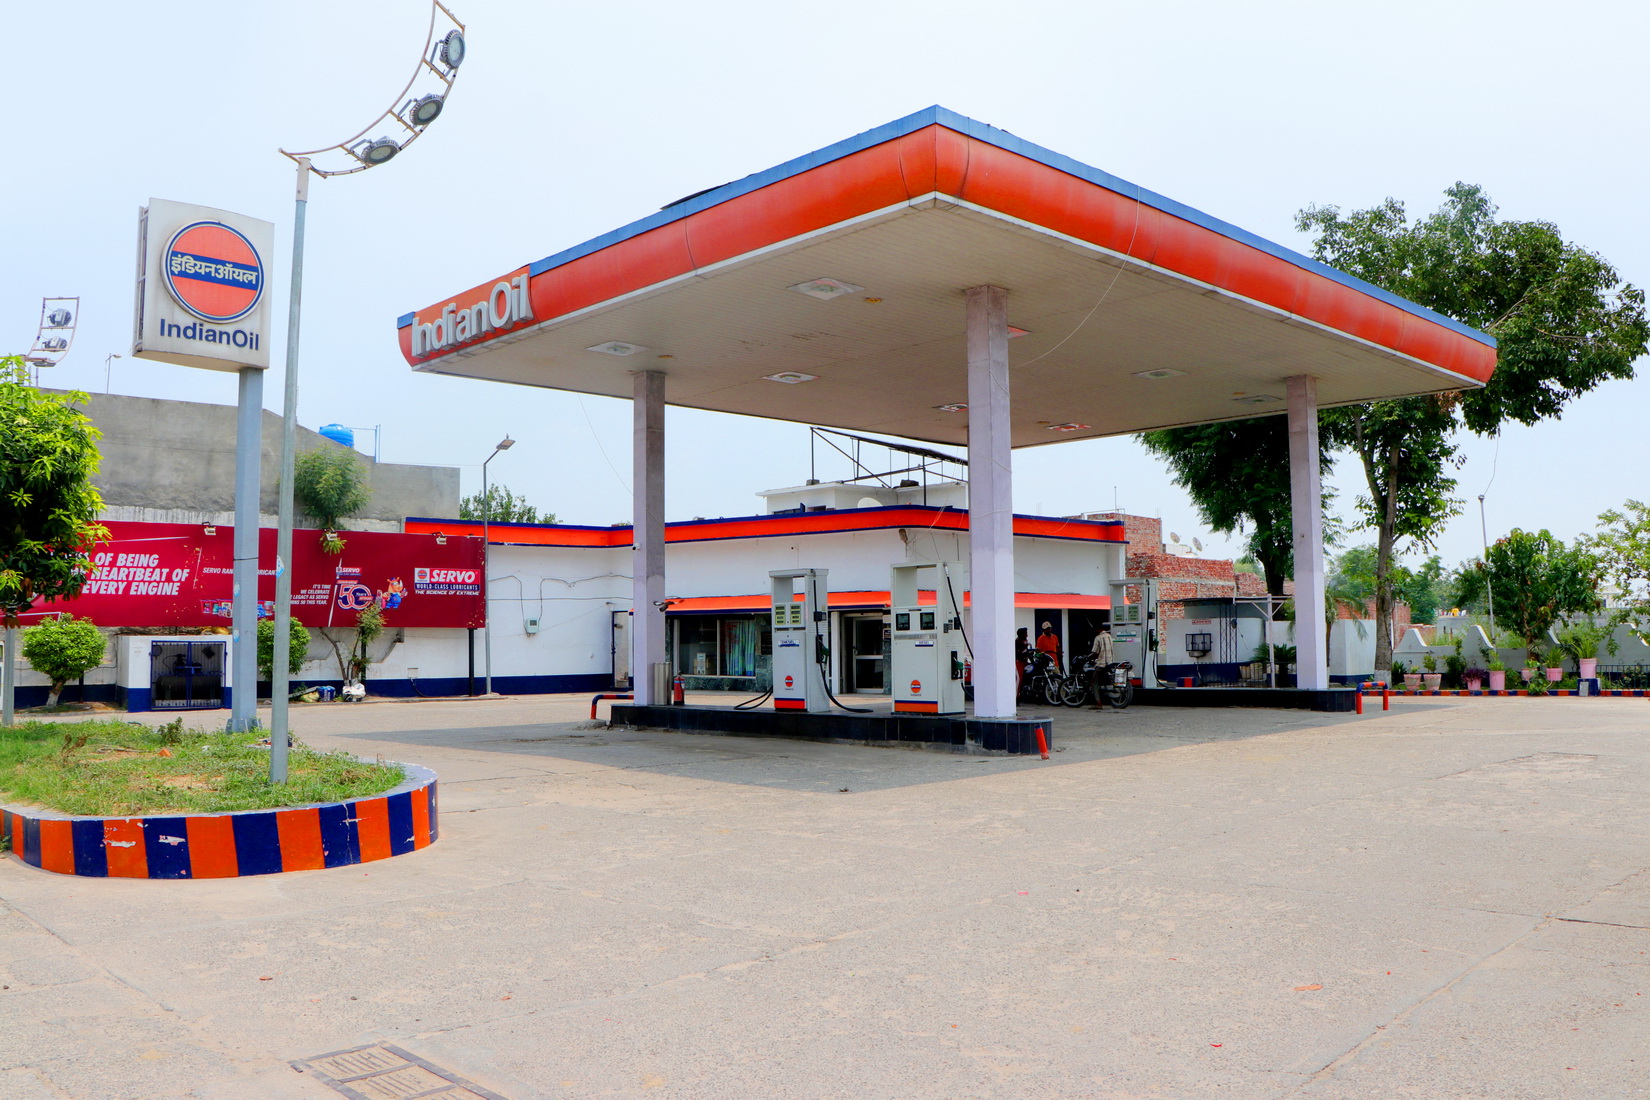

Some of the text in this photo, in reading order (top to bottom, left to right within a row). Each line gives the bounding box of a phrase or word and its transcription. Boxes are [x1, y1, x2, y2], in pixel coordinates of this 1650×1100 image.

[171, 253, 258, 285] इंडियनऑयल
[411, 273, 534, 358] IndianOil
[160, 318, 259, 351] IndianOil
[94, 552, 114, 566] OF
[116, 553, 159, 567] BEING
[171, 568, 190, 582] OF
[430, 569, 476, 583] SERVO
[81, 581, 181, 596] EVERY ENGINE
